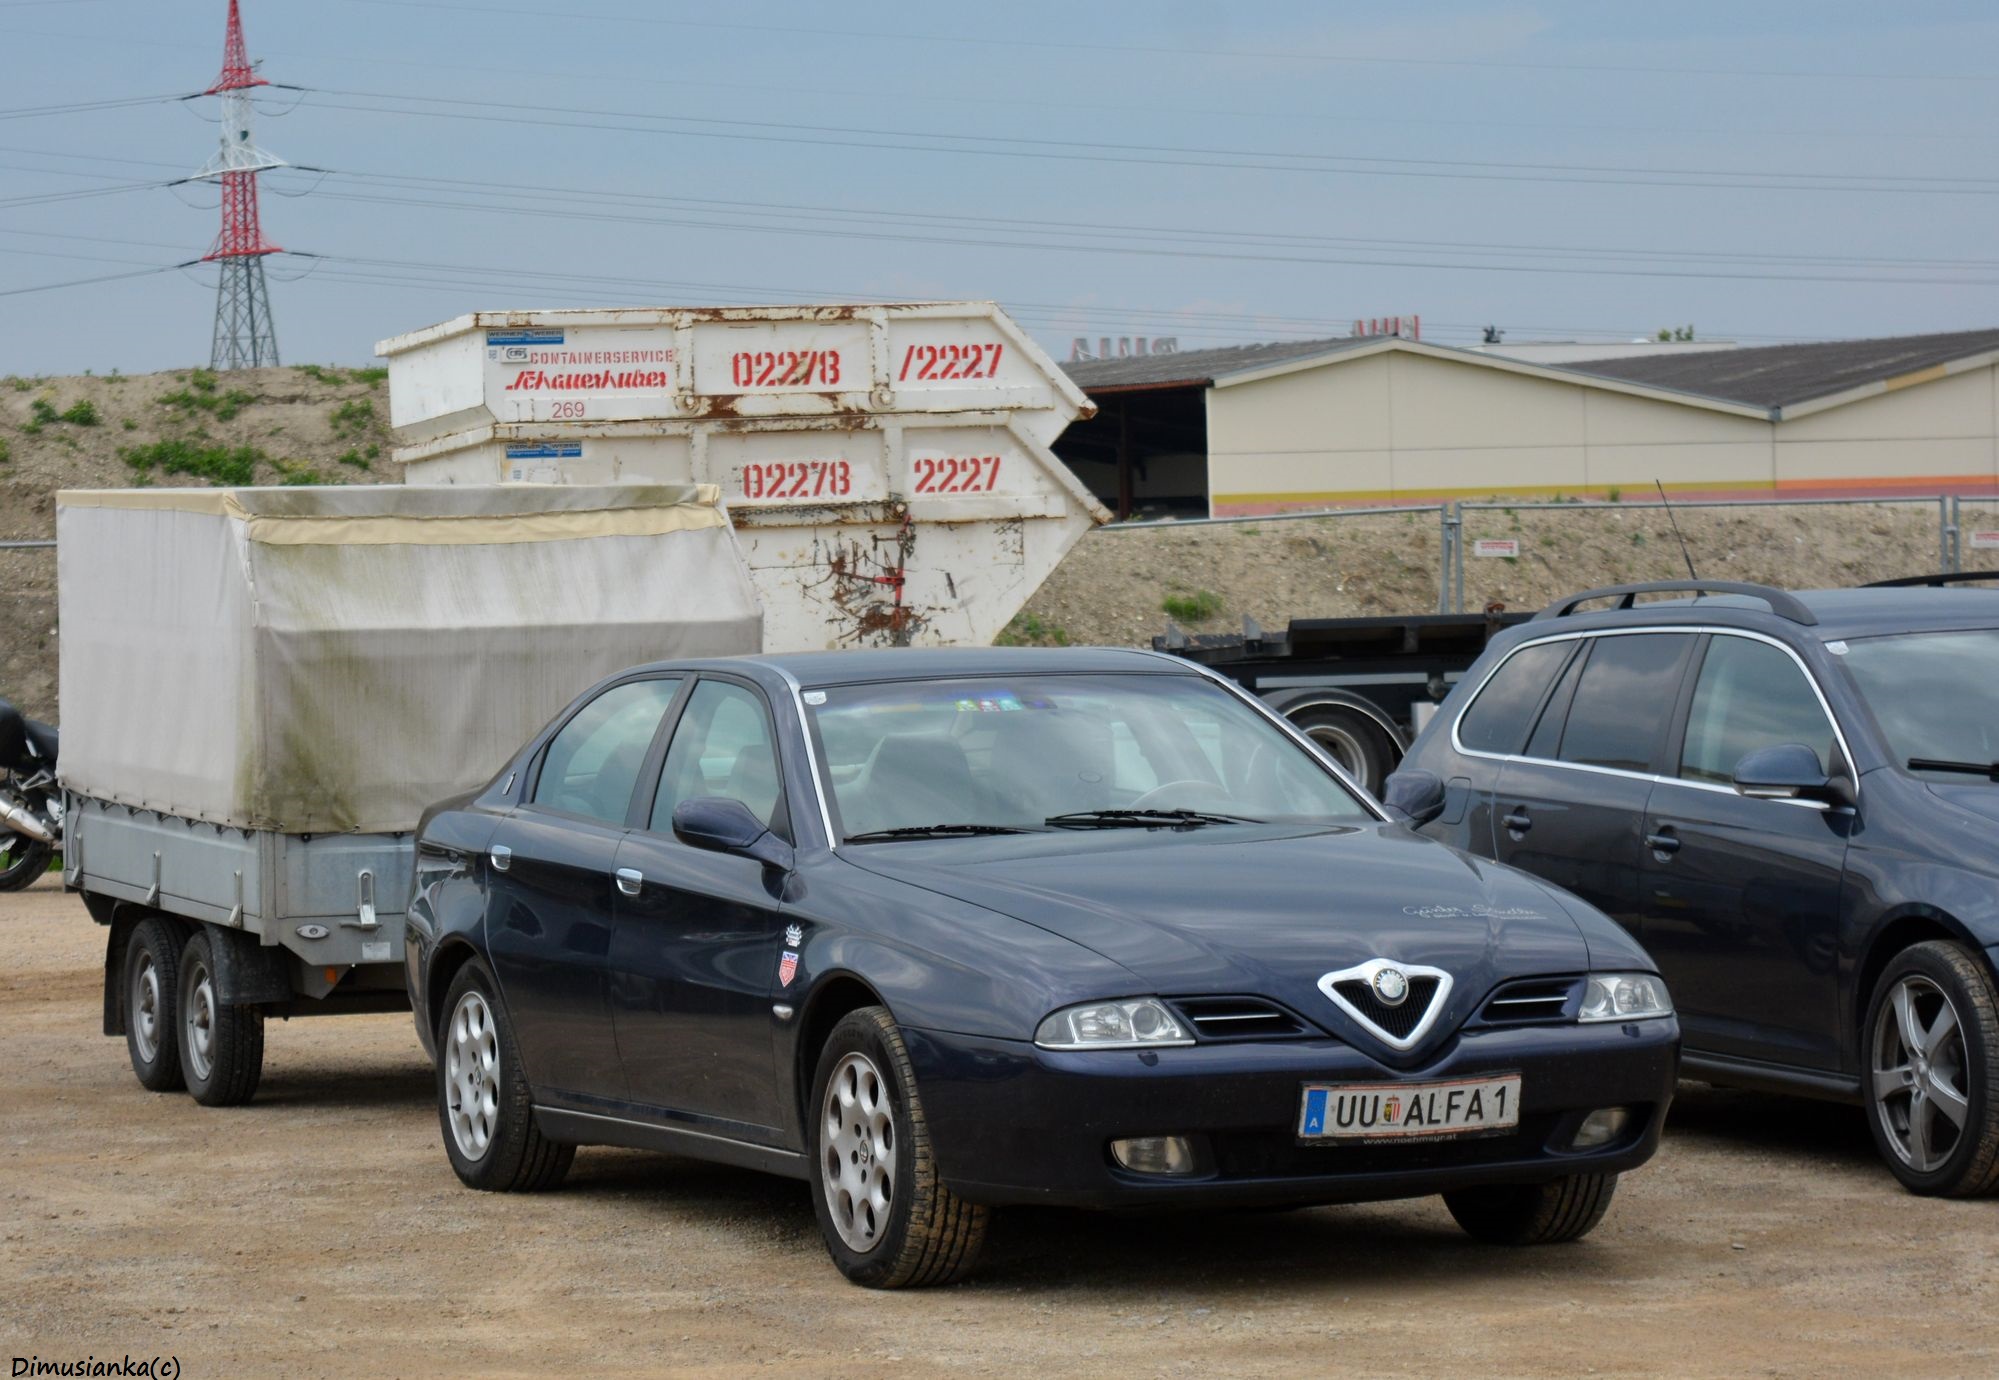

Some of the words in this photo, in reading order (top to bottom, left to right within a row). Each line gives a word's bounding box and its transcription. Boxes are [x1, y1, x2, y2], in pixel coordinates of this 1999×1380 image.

[530, 350, 673, 365] CONTAINERSERVICE
[732, 350, 840, 387] 02278
[552, 402, 585, 418] 269
[914, 457, 1001, 493] 2227
[1337, 1095, 1379, 1128] UU
[1403, 1088, 1484, 1127] ALFA
[1309, 1117, 1319, 1128] A
